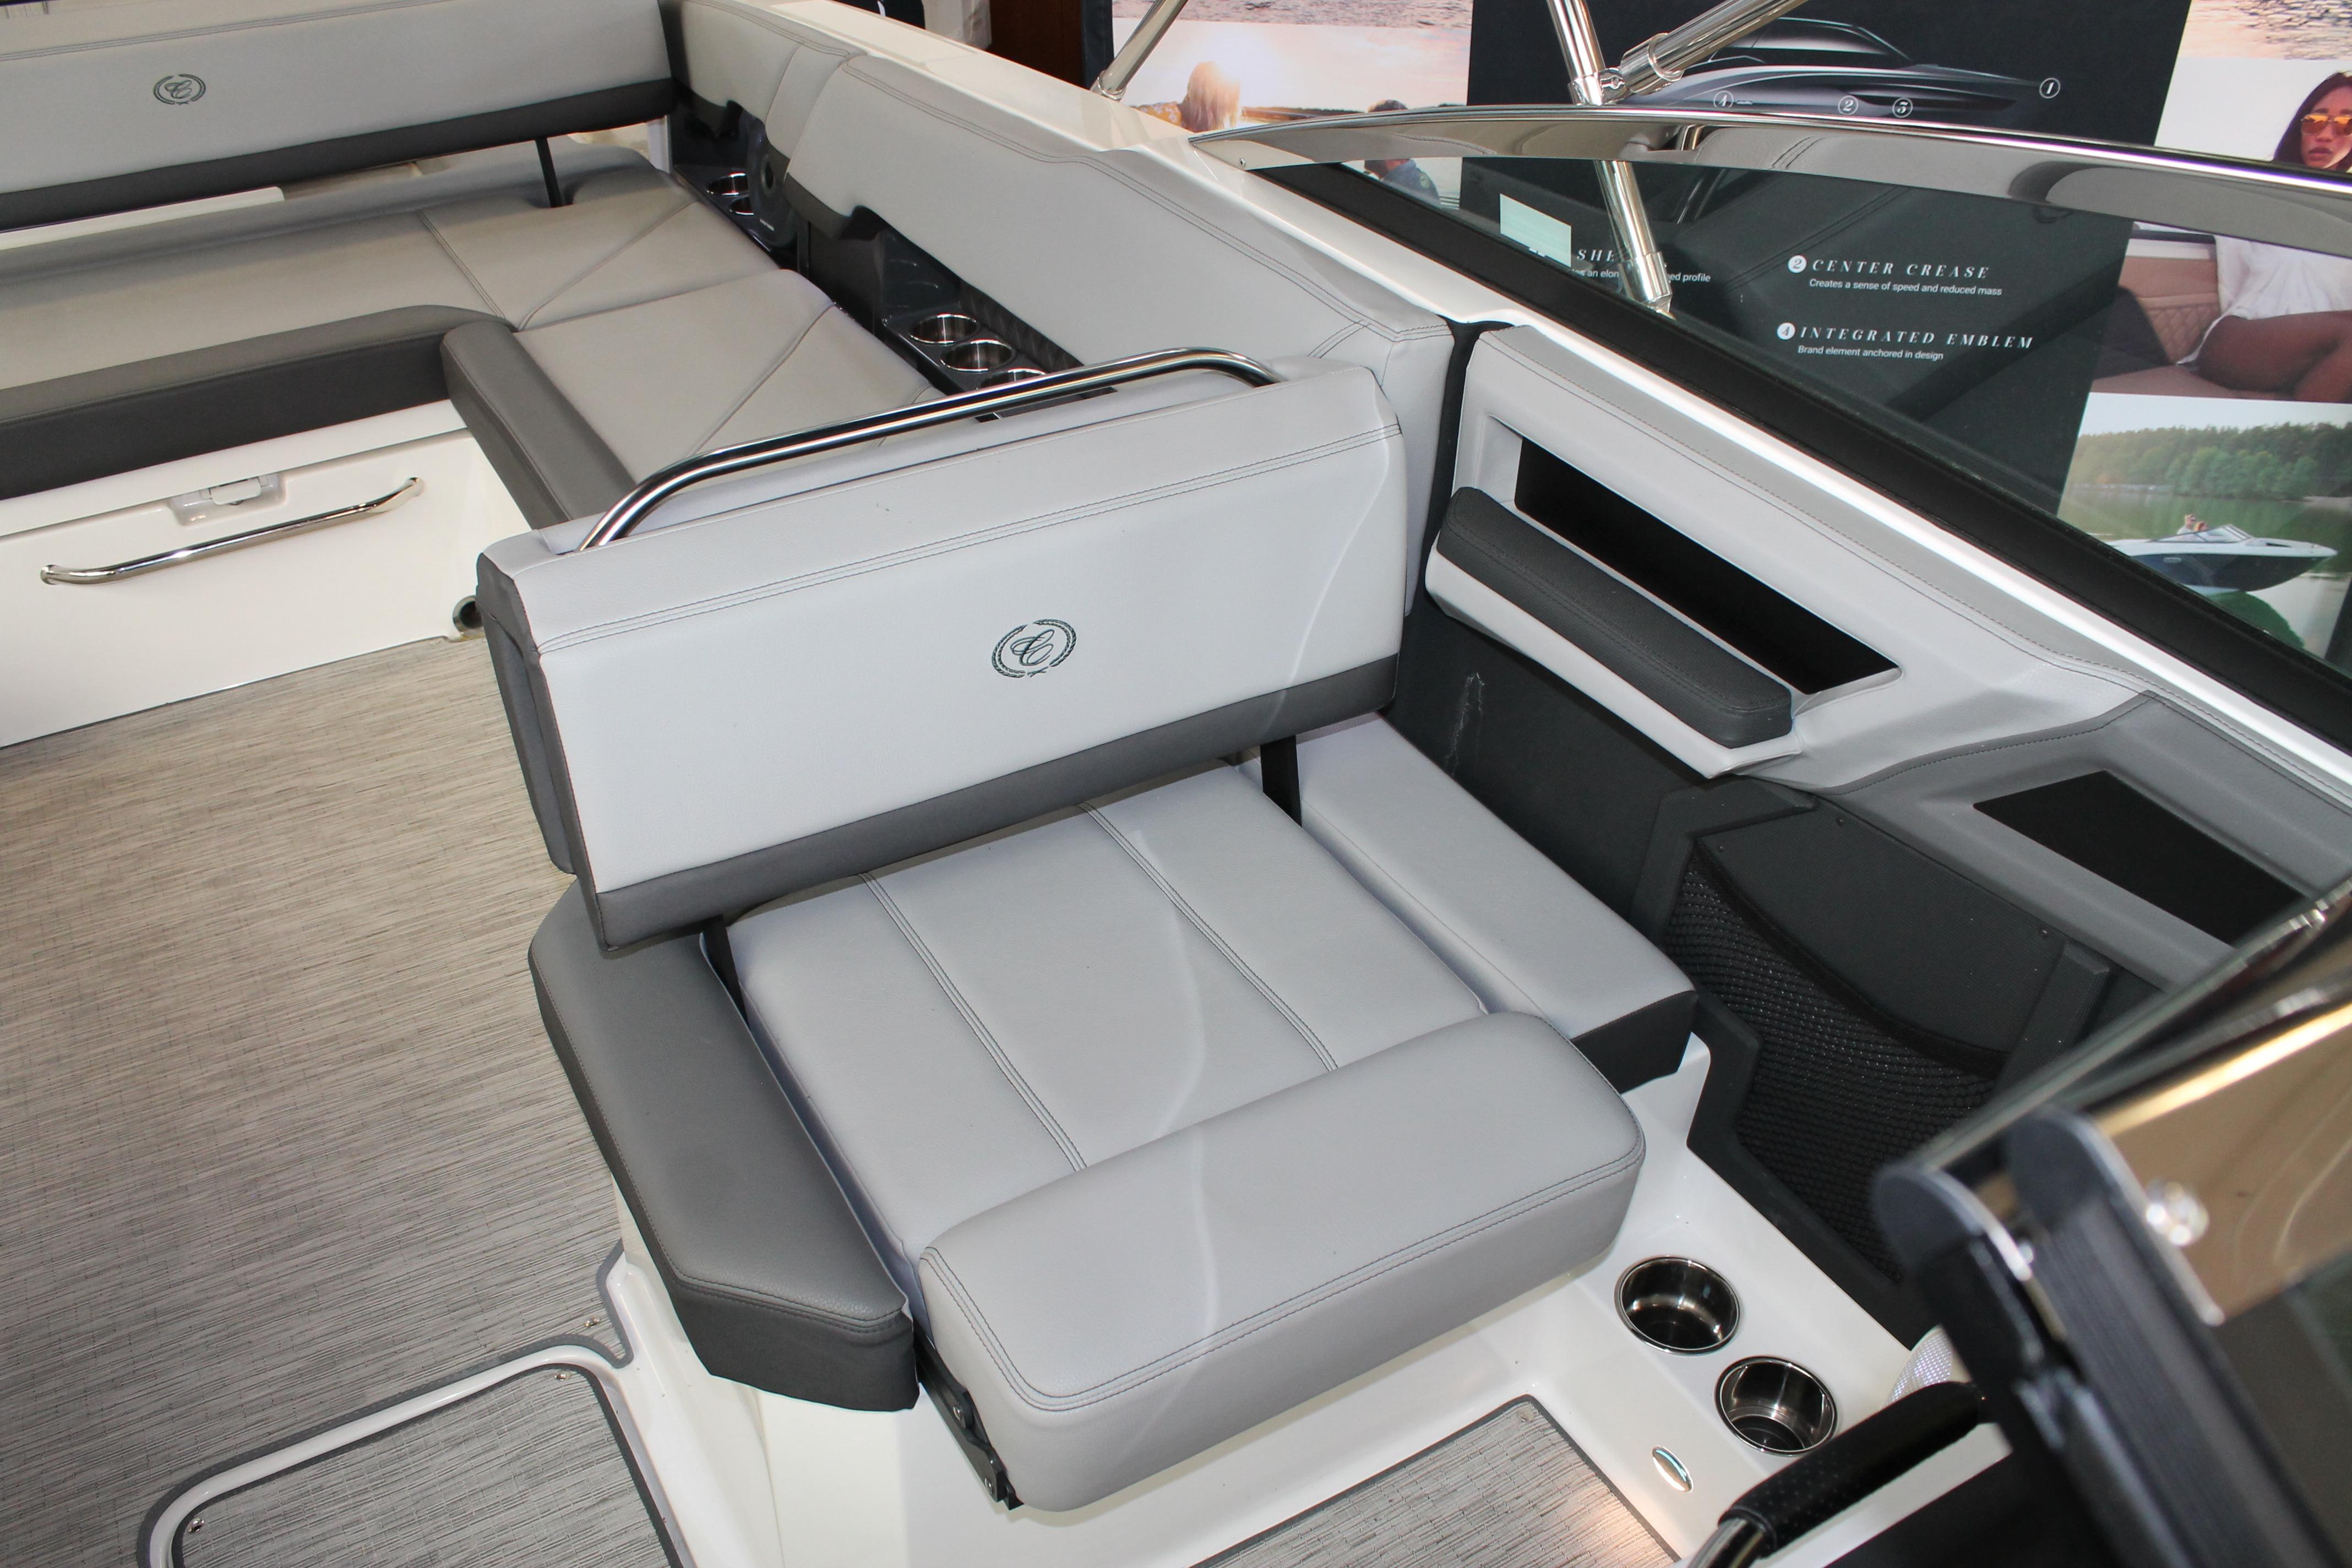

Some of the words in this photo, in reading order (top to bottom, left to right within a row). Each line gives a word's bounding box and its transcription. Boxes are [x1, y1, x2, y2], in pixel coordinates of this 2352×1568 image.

[1812, 259, 1894, 274] CENTER
[1906, 264, 1989, 279] CREASE
[1683, 273, 1711, 283] profile
[1809, 279, 1843, 288] Creates
[1853, 282, 1879, 290] sense
[1881, 281, 1892, 290] of
[1892, 283, 1920, 293] speed
[1921, 284, 1939, 293] and
[1940, 285, 1977, 295] reduced
[1978, 287, 2002, 296] mass
[1800, 326, 1935, 344] INTEGRATED
[1947, 333, 2034, 349] EMBLEM
[1798, 345, 1824, 354] Brand
[1826, 346, 1860, 356] element
[1863, 348, 1903, 358] anchored
[1905, 350, 1913, 358] in
[1915, 351, 1944, 362] design
